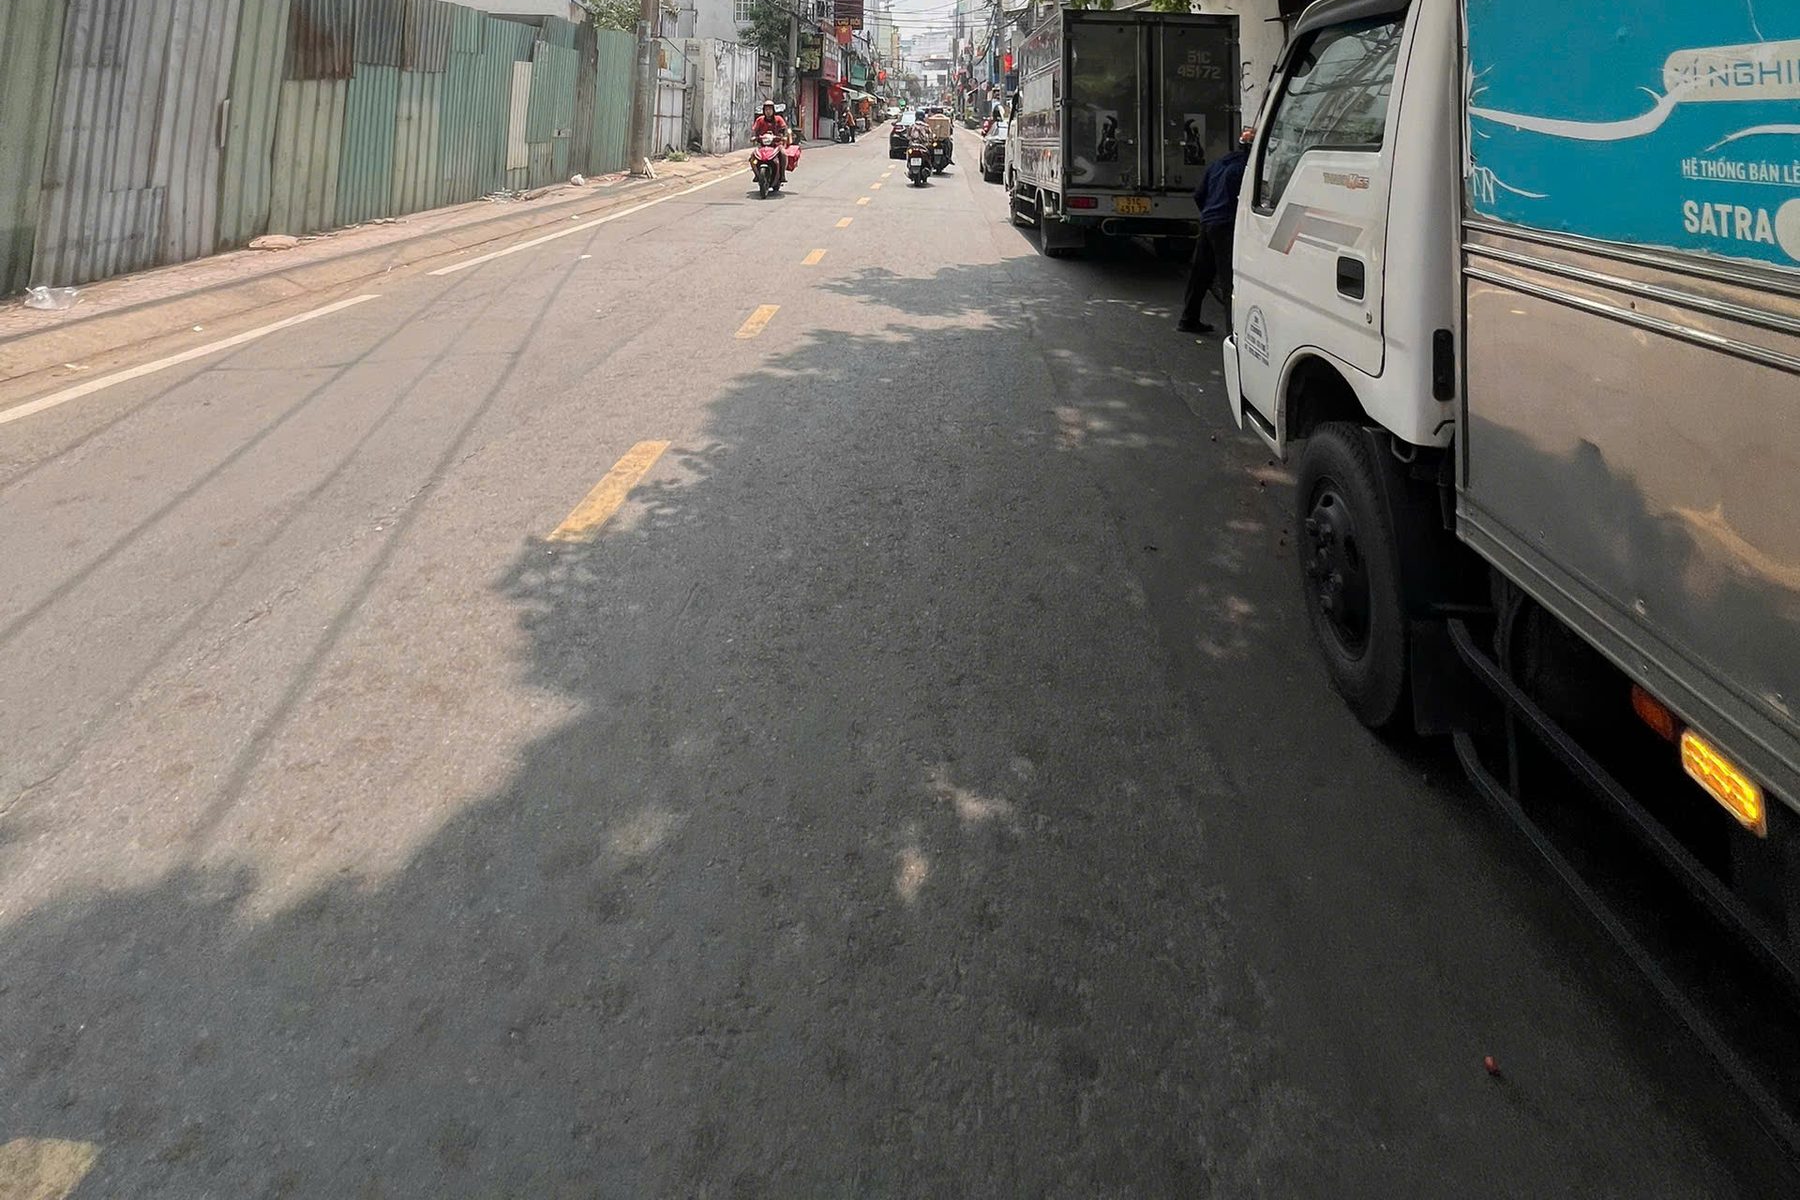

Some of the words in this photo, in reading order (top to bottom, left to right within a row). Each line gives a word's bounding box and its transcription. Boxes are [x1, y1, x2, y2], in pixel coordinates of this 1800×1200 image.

[1187, 50, 1211, 64] 51C
[1707, 59, 1800, 87] NGHI
[1700, 156, 1746, 180] THỐNG
[1749, 160, 1779, 182] BÁN
[1682, 199, 1775, 245] SATRA
